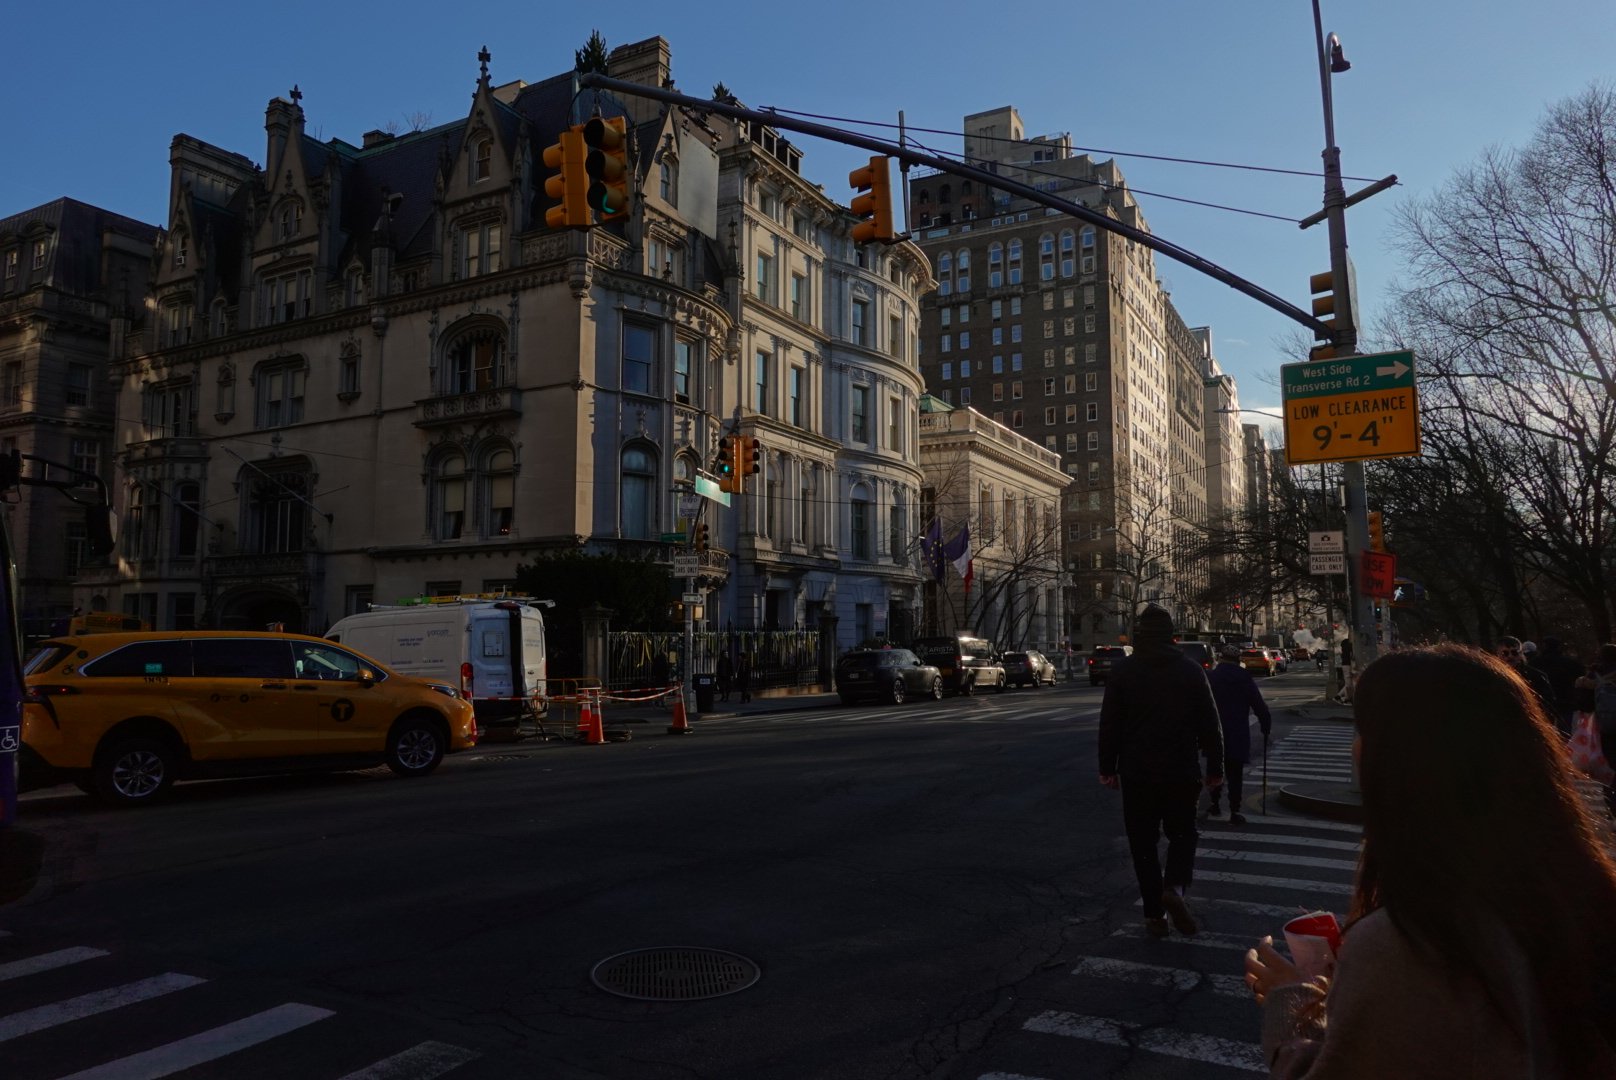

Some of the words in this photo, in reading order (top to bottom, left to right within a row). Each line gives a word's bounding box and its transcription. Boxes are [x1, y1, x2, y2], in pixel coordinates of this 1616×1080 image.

[1302, 366, 1326, 378] West
[1330, 364, 1352, 375] Side
[1286, 381, 1342, 393] Transverse
[1346, 377, 1360, 387] Rd
[1363, 375, 1371, 386] 2
[1294, 405, 1319, 420] LOW
[1328, 396, 1407, 417] CLEARANCE
